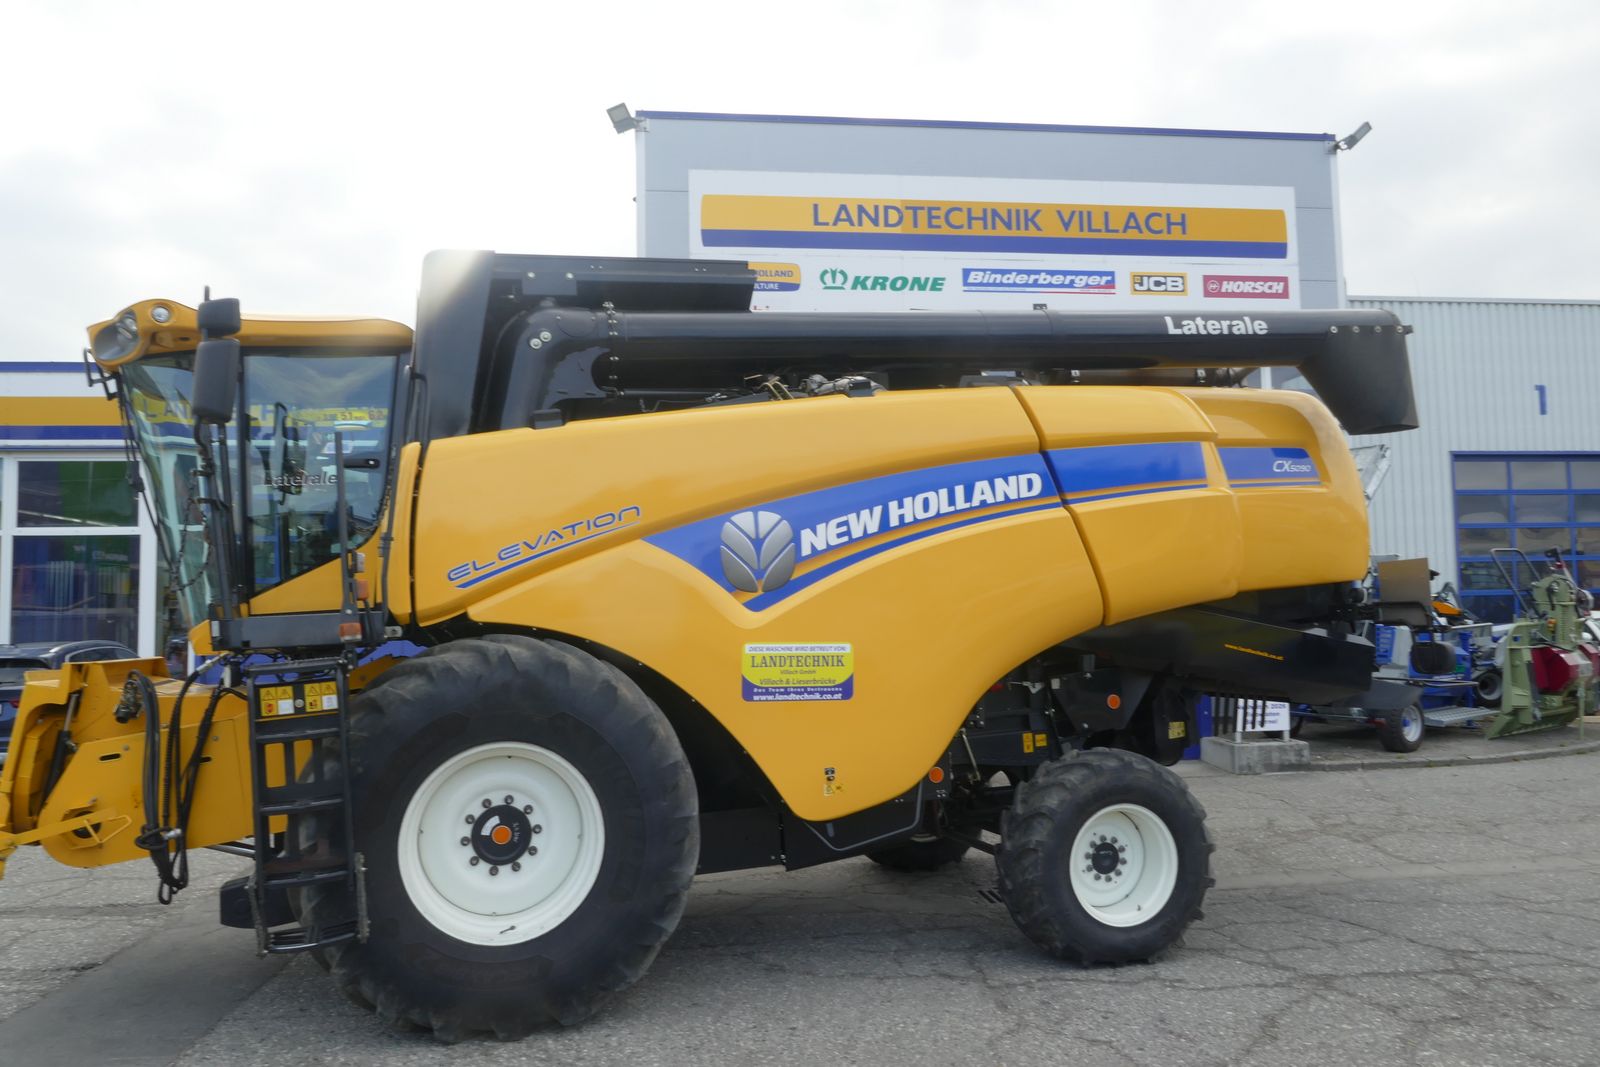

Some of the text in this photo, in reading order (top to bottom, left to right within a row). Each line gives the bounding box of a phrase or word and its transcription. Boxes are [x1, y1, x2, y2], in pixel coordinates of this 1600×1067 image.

[812, 203, 1188, 235] LANDTECHNIK VILLACH
[851, 275, 946, 291] KRONE
[967, 271, 1112, 288] Binderberger
[1134, 276, 1185, 292] JCB
[1221, 281, 1285, 293] HORSCH
[1164, 316, 1268, 335] Laterale
[800, 472, 1043, 557] NEW HOLLAND
[447, 505, 641, 582] ELEVATION
[751, 654, 845, 668] LANDTECHNIK
[753, 692, 842, 701] www.landtechnik.co.at
